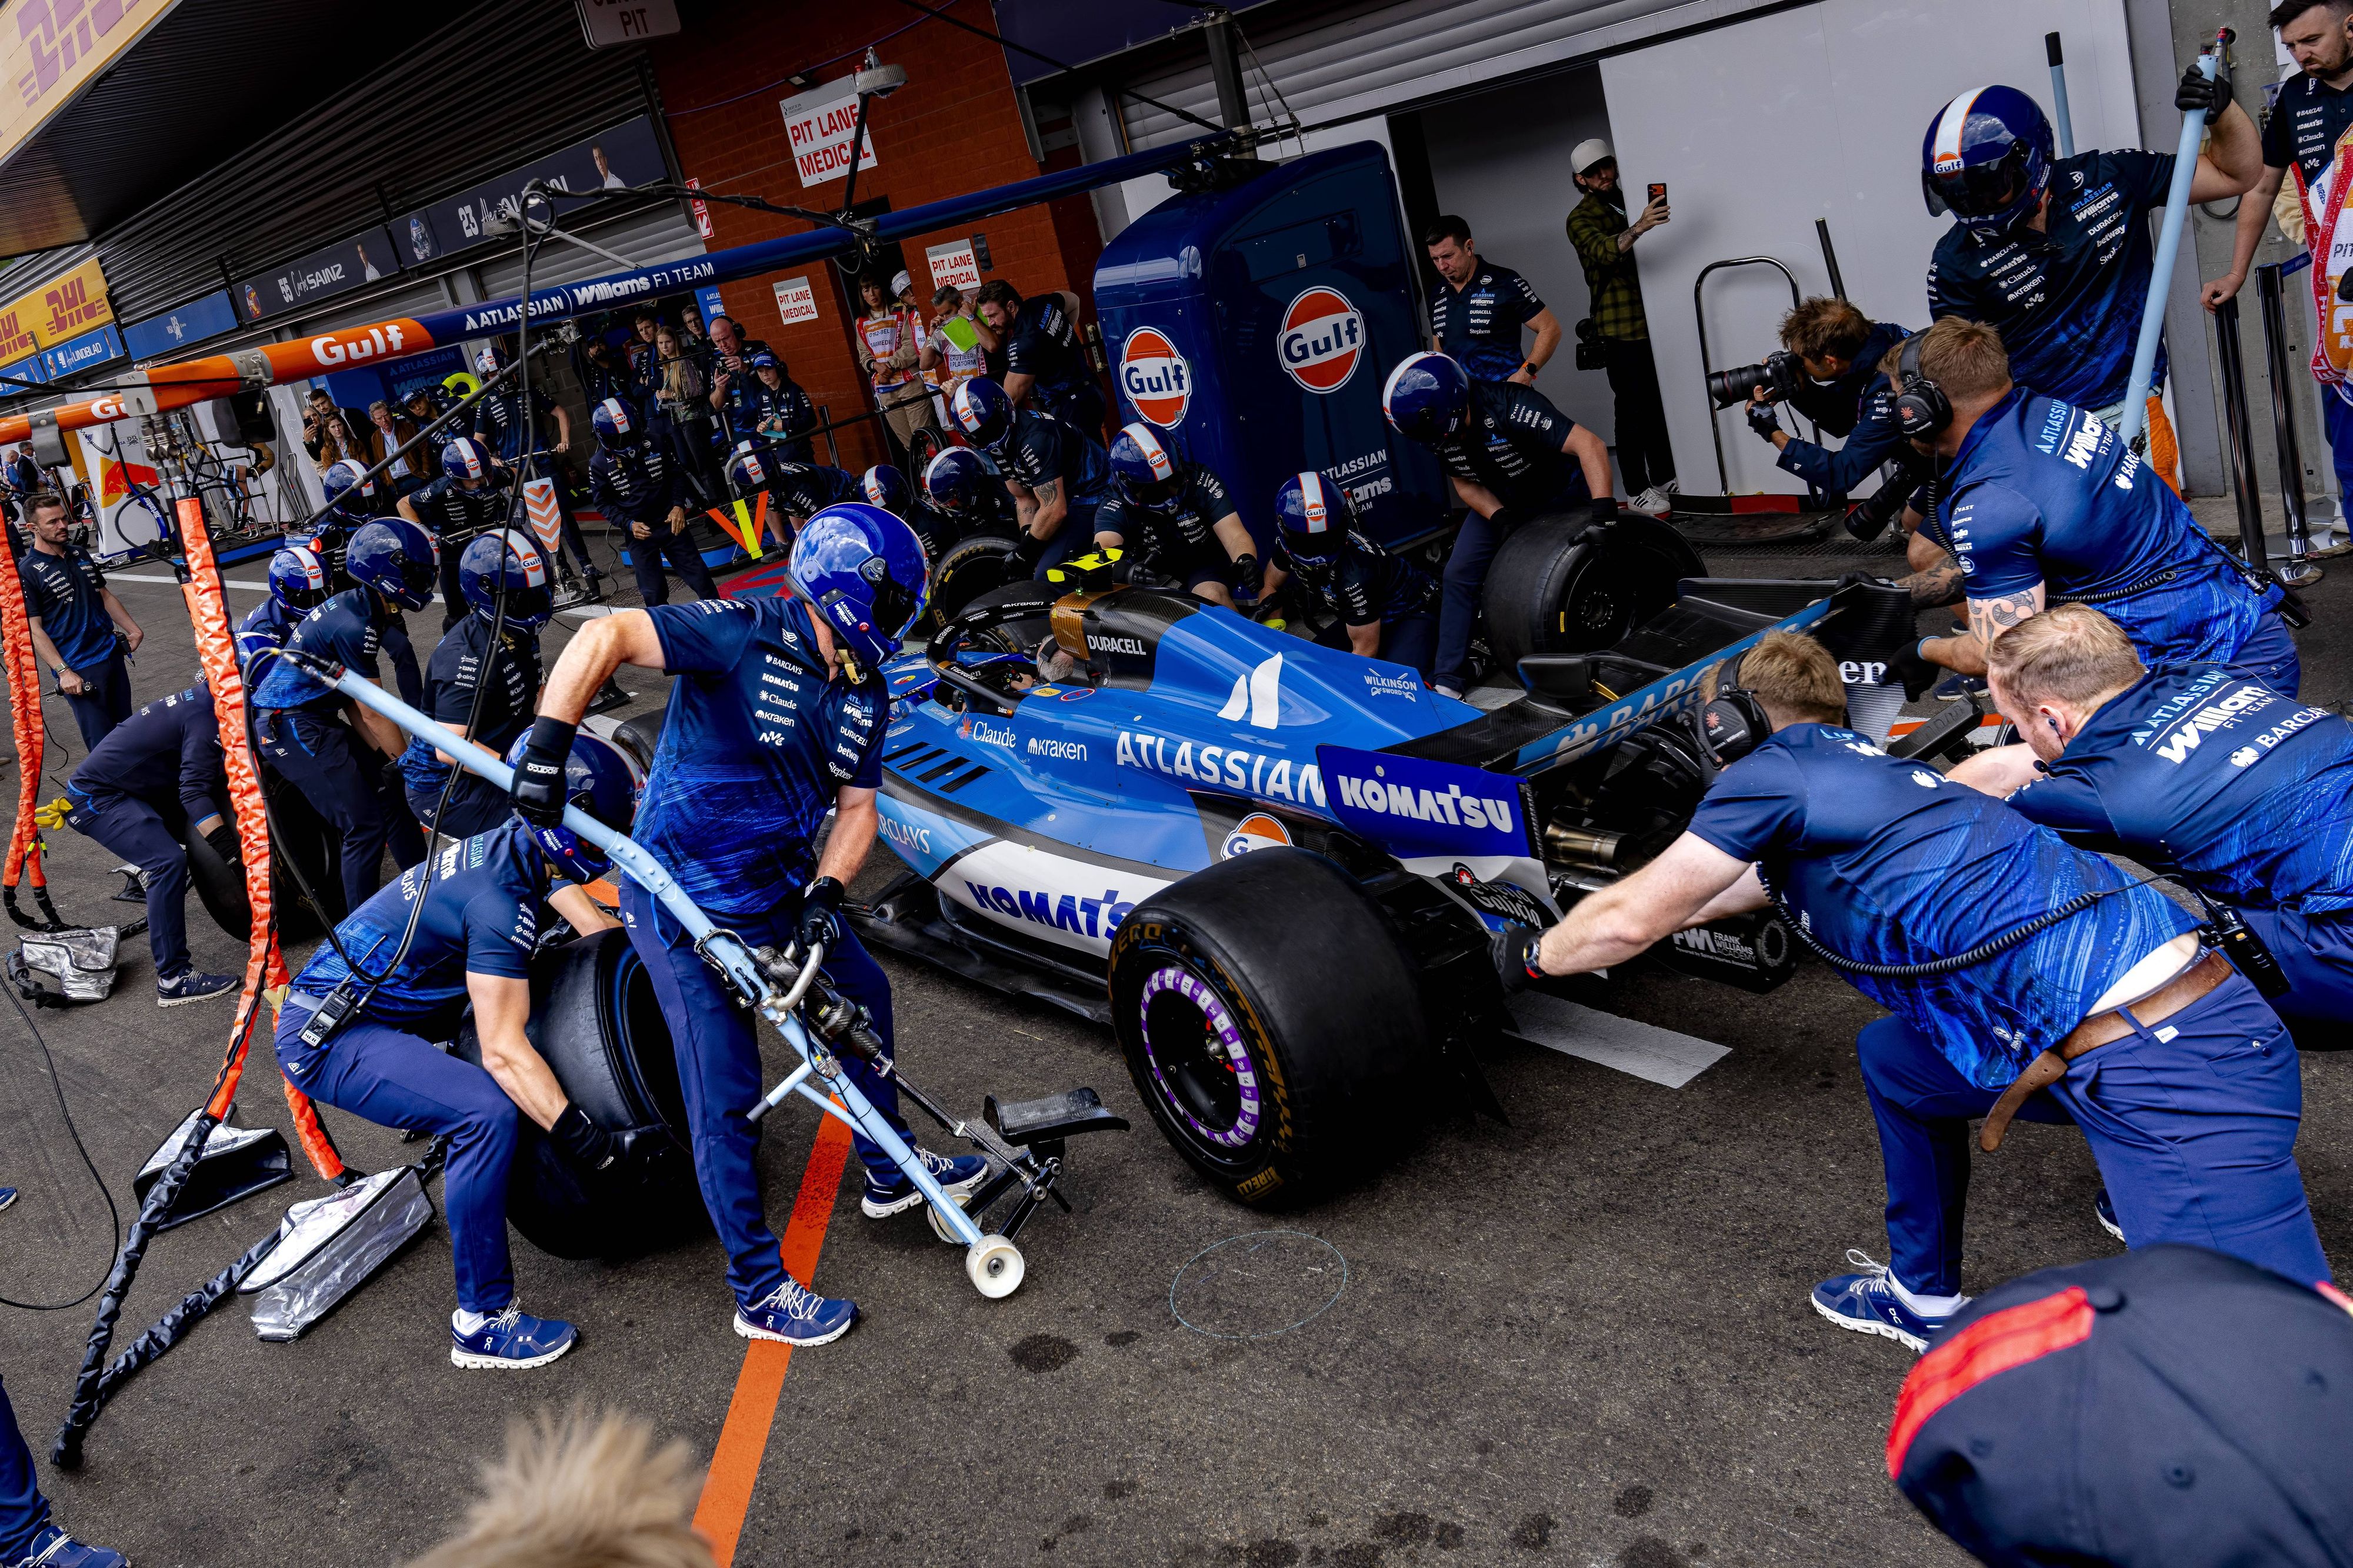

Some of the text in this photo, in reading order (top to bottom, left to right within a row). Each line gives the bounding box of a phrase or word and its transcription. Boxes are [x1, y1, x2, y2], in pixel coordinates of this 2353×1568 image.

[619, 9, 649, 36] PIT
[2301, 106, 2323, 116] BARCLAYS
[790, 104, 859, 147] PIT LANE
[2297, 119, 2323, 130] KOMATSU
[2302, 132, 2324, 142] Claude
[2302, 144, 2325, 155] kraken
[1935, 160, 1962, 172] Gulf
[2071, 181, 2113, 212] ATLASSIAN
[2075, 191, 2119, 222] Williams
[2096, 205, 2111, 215] TEAM
[458, 205, 479, 238] 23
[2088, 209, 2124, 236] DURACELL
[2096, 223, 2127, 248] betway
[932, 253, 973, 272] PIT LANE
[1987, 242, 2018, 264] BARCLAYS
[1990, 253, 2028, 277] KOMATSU
[2007, 264, 2037, 285] Claude
[278, 277, 294, 303] 55
[306, 263, 345, 290] SAINZ
[572, 276, 651, 306] Williams
[652, 273, 671, 288] F1
[672, 262, 715, 282] TEAM
[936, 271, 977, 289] MEDICAL
[2014, 274, 2045, 299] kraken
[778, 289, 811, 305] PIT LANE
[782, 304, 815, 319] MEDICAL
[311, 325, 404, 367] Gulf
[1283, 318, 1359, 363] Gulf
[73, 342, 102, 362] LINDBLAD
[399, 351, 456, 373] ATLASSIAN
[1124, 364, 1185, 395] Gulf
[959, 410, 973, 420] Gulf
[1149, 453, 1166, 464] Gulf
[2099, 445, 2108, 456] F1
[1323, 449, 1387, 479] TLASSIAN
[1178, 516, 1200, 528] Williams
[1306, 508, 1327, 517] Gulf
[523, 558, 541, 567] Gulf
[57, 582, 71, 591] Claude
[834, 603, 852, 627] Williams
[842, 603, 858, 623] ATLASSIAN
[939, 625, 955, 642] kraken
[1086, 635, 1147, 656] DURACELL
[772, 657, 803, 675] BARCLAYS
[762, 673, 799, 692] KOMATSU
[1364, 675, 1418, 692] WILKINSON
[1381, 686, 1403, 696] SWORD
[769, 694, 797, 709] Claude
[764, 712, 795, 728] kraken
[2222, 696, 2277, 730] F1 TEAM
[2156, 685, 2271, 765] William
[2254, 706, 2331, 749] BARCLAY
[840, 726, 868, 746] DURACELL
[972, 722, 1016, 749] Claude
[837, 743, 859, 764] betway
[1038, 737, 1087, 762] kraken
[527, 762, 559, 775] sparco
[828, 762, 853, 780] Stephens
[1116, 730, 1326, 808] ATLASSIAN
[1338, 775, 1514, 834] KOMATSU
[963, 880, 1139, 941] KOMATS
[1471, 889, 1541, 929] Galicia
[522, 917, 536, 929] BNY
[511, 935, 532, 951] nuveen
[1714, 932, 1741, 945] FRANK
[1714, 939, 1754, 955] WILLIAMS
[1717, 947, 1756, 962] ACADEMY
[1242, 1076, 1249, 1085] 14
